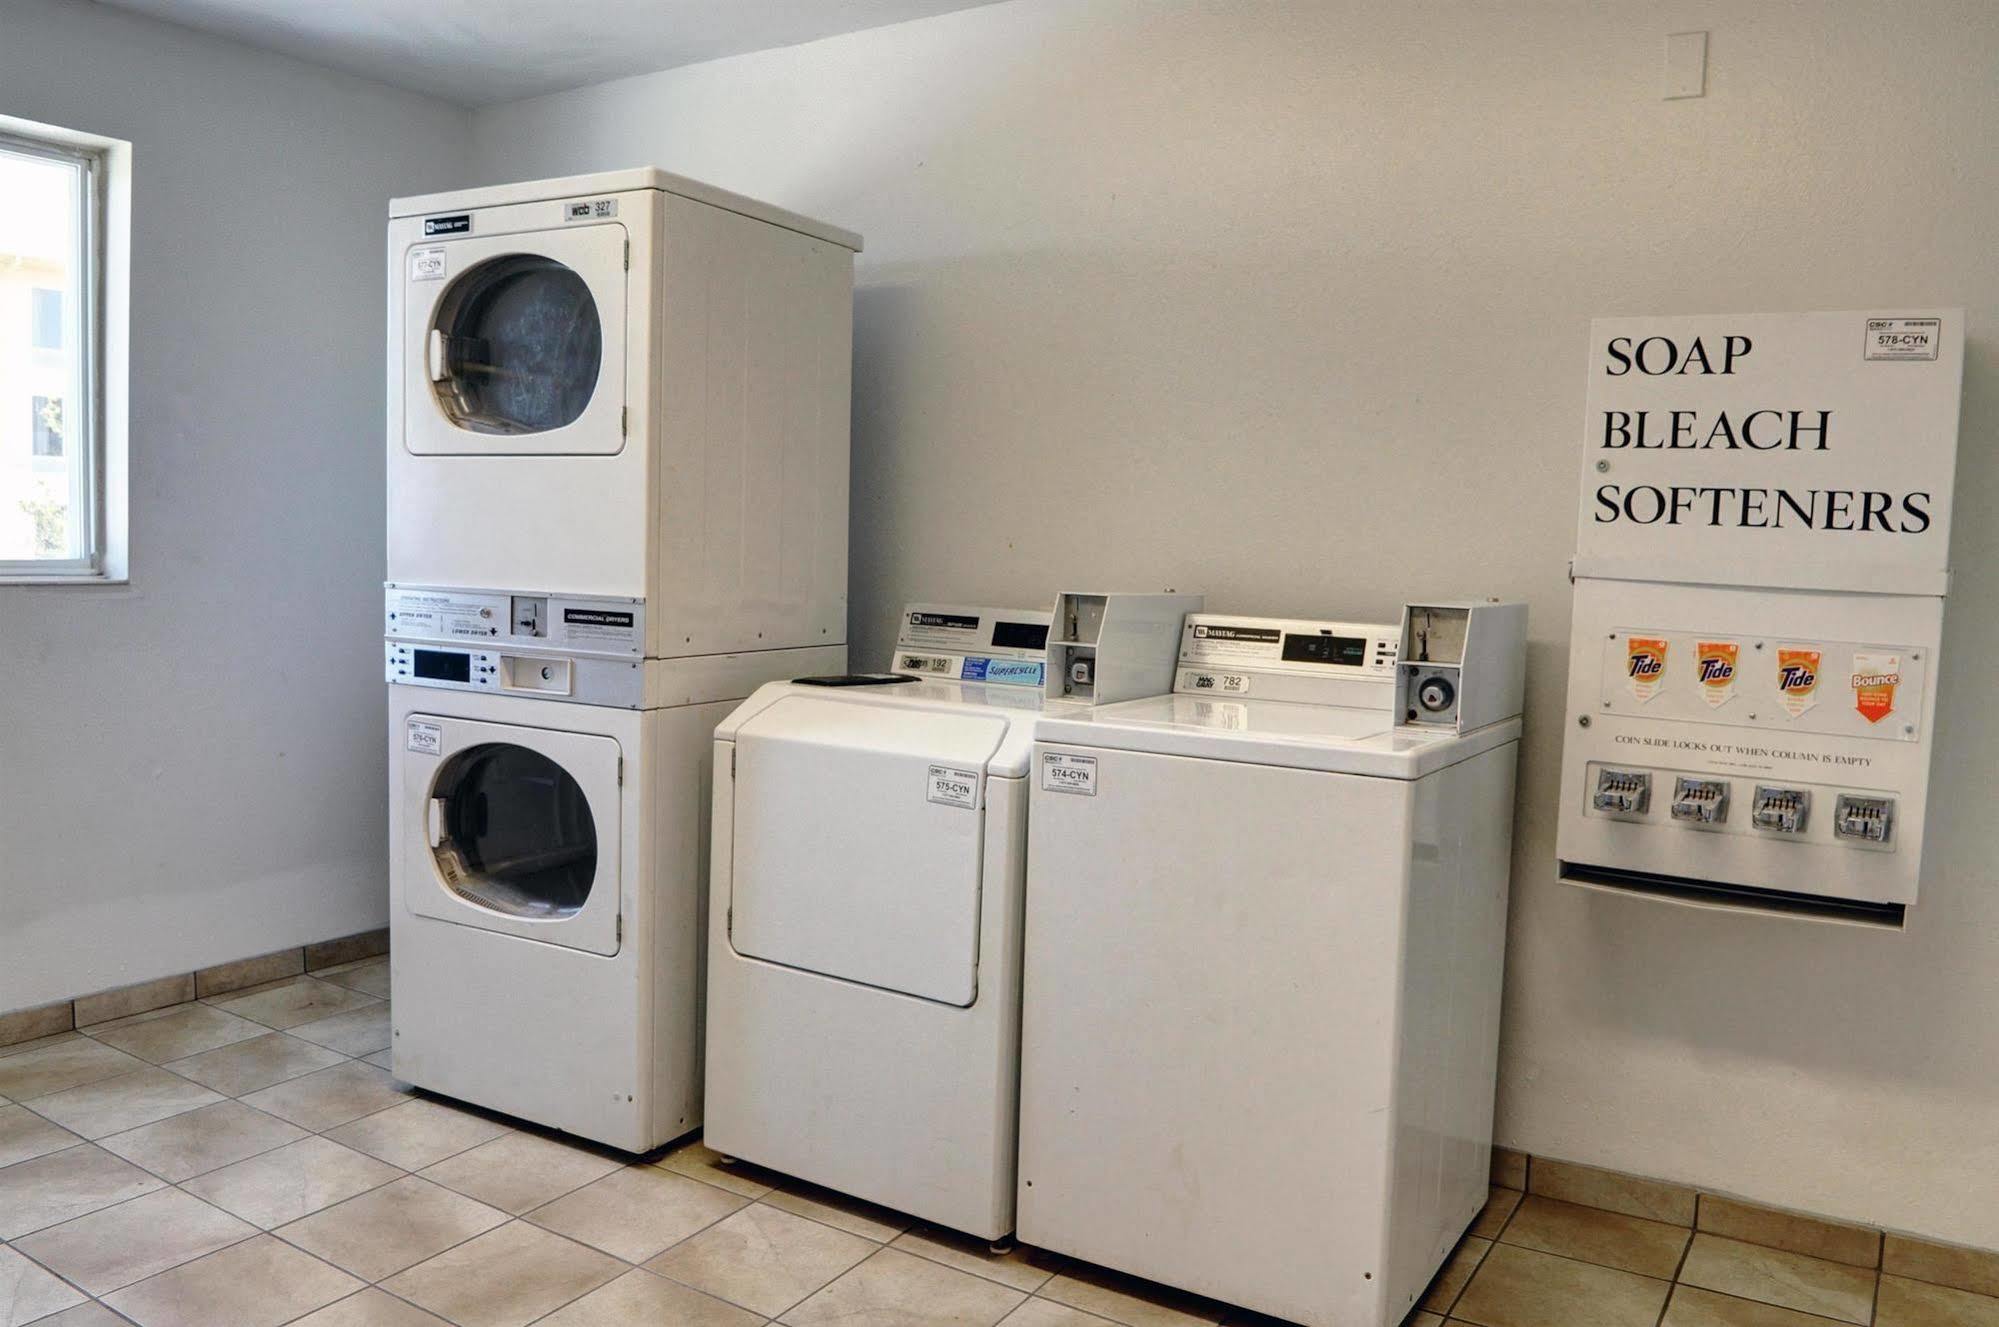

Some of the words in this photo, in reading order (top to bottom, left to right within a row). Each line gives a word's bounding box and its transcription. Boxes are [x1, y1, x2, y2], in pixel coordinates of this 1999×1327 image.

[595, 200, 610, 211] 327
[1878, 335, 1929, 344] 578-CYN
[1606, 336, 1752, 376] SOAP
[1600, 410, 1833, 450] BLEACH
[1594, 485, 1931, 533] SOFTENERS
[567, 613, 604, 622] COMMERCIAL
[932, 659, 947, 668] 192
[1629, 655, 1662, 677] Tide
[1699, 659, 1733, 682] Tide
[1223, 676, 1242, 686] 782
[1780, 667, 1815, 690] Tide
[1852, 674, 1899, 688] Bounce
[1615, 735, 1640, 745] COIN
[1643, 737, 1670, 747] SLIDE
[1673, 741, 1707, 751] LOCKS
[1710, 744, 1731, 753] OUT
[1736, 746, 1768, 757] WHEN
[1771, 749, 1819, 761] COLUMN
[1822, 754, 1832, 762] IS
[1834, 756, 1872, 767] EMPTY
[1052, 768, 1089, 780] 574-CYN
[936, 781, 970, 794] 575-CYN
